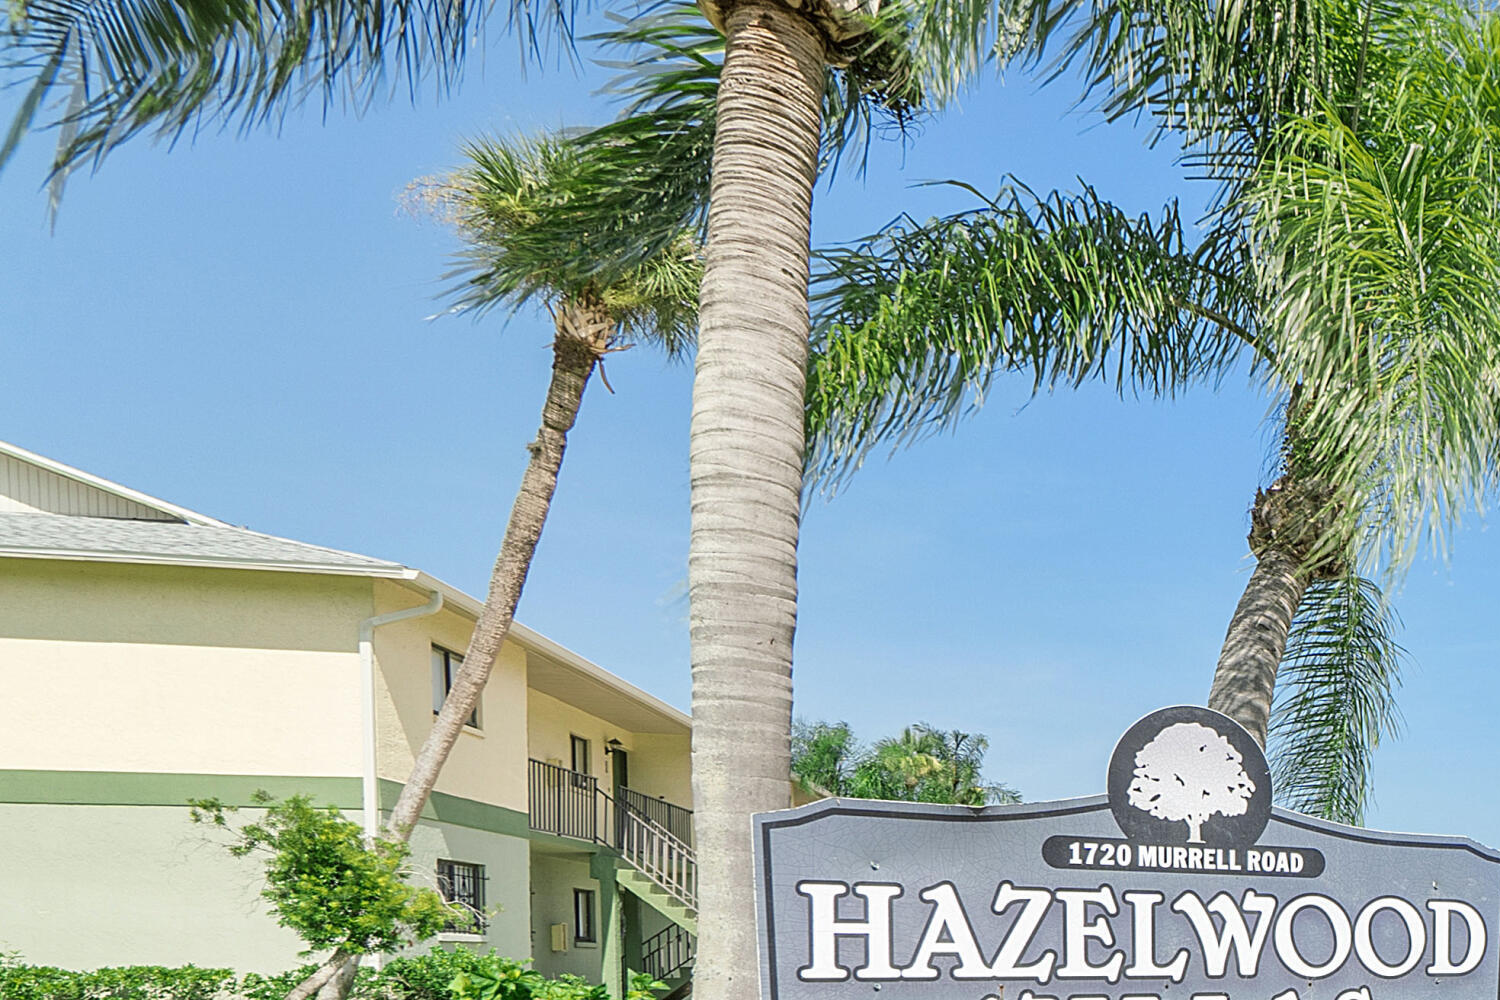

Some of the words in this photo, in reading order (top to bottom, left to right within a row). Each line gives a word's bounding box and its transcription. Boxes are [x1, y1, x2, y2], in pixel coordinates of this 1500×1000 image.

[1068, 842, 1132, 866] 1720
[1138, 845, 1241, 871] MURRELL
[1248, 850, 1304, 873] ROAD
[799, 882, 1488, 984] HAZELWOOD
